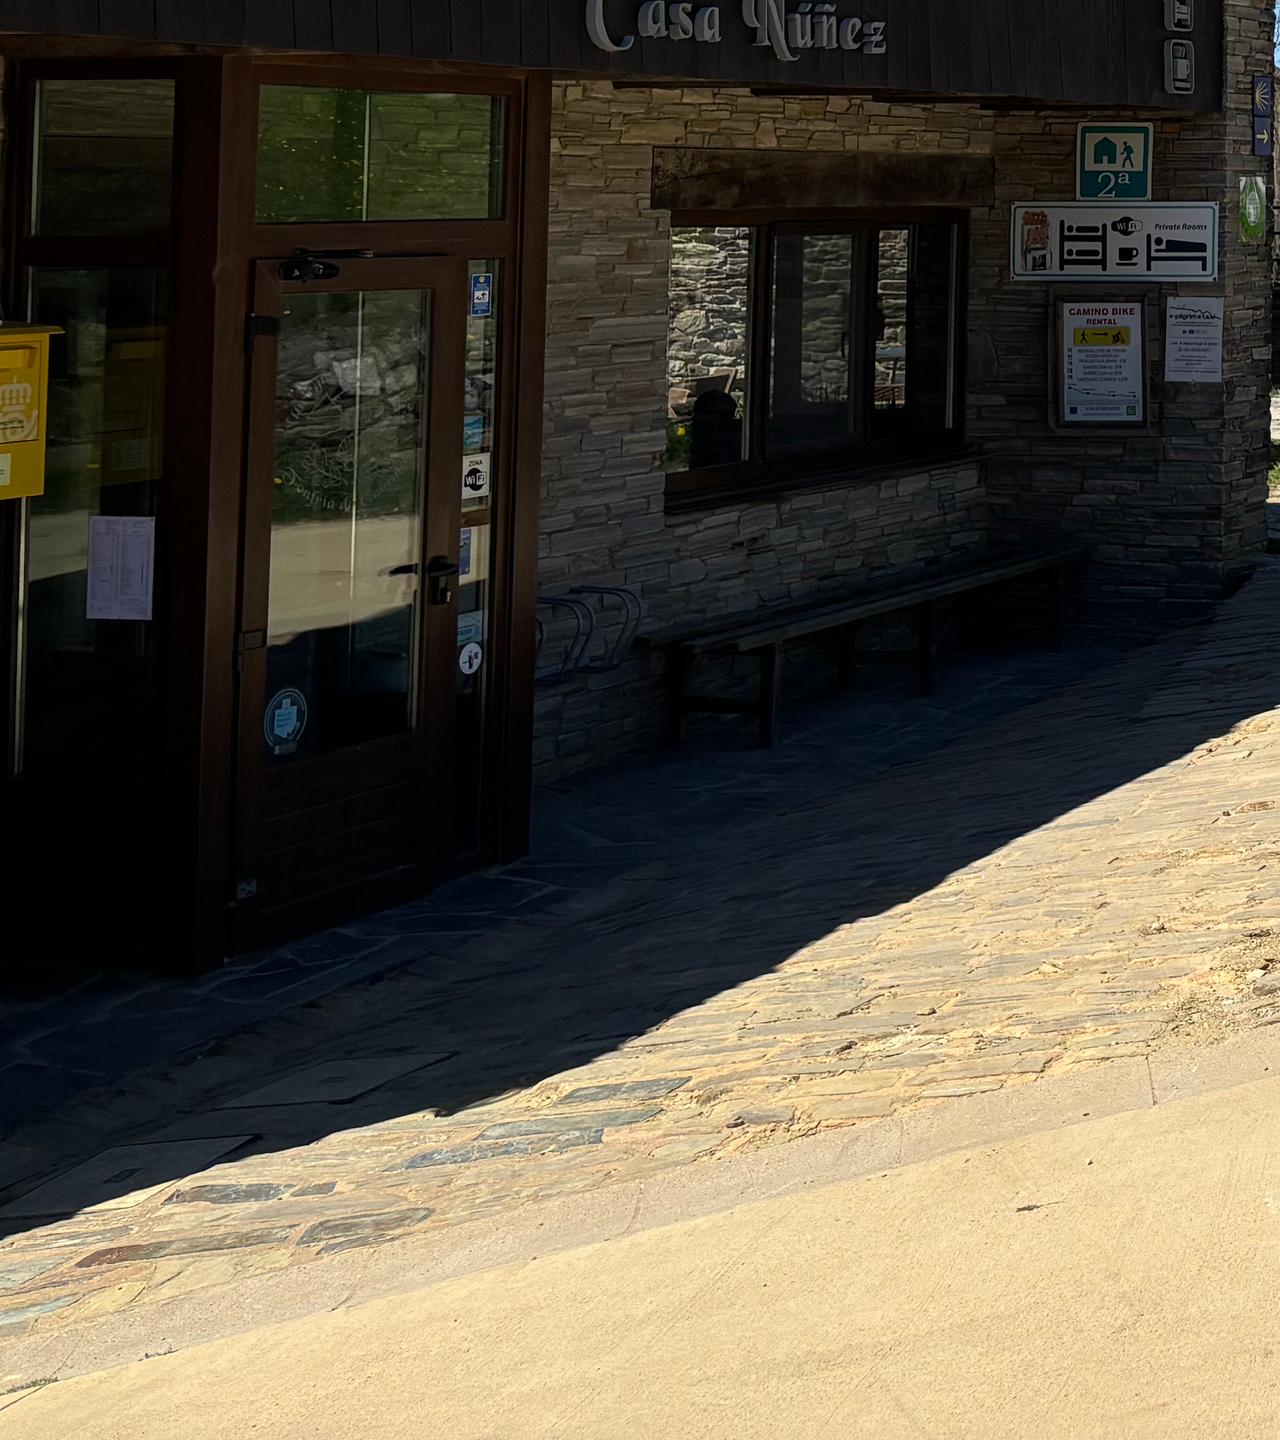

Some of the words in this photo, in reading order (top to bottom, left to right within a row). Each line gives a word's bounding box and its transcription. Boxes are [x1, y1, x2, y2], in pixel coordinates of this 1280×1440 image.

[1154, 223, 1180, 231] Private
[1181, 223, 1208, 231] Rooms
[1069, 308, 1109, 316] CAMINO
[1112, 308, 1136, 316] BIKE
